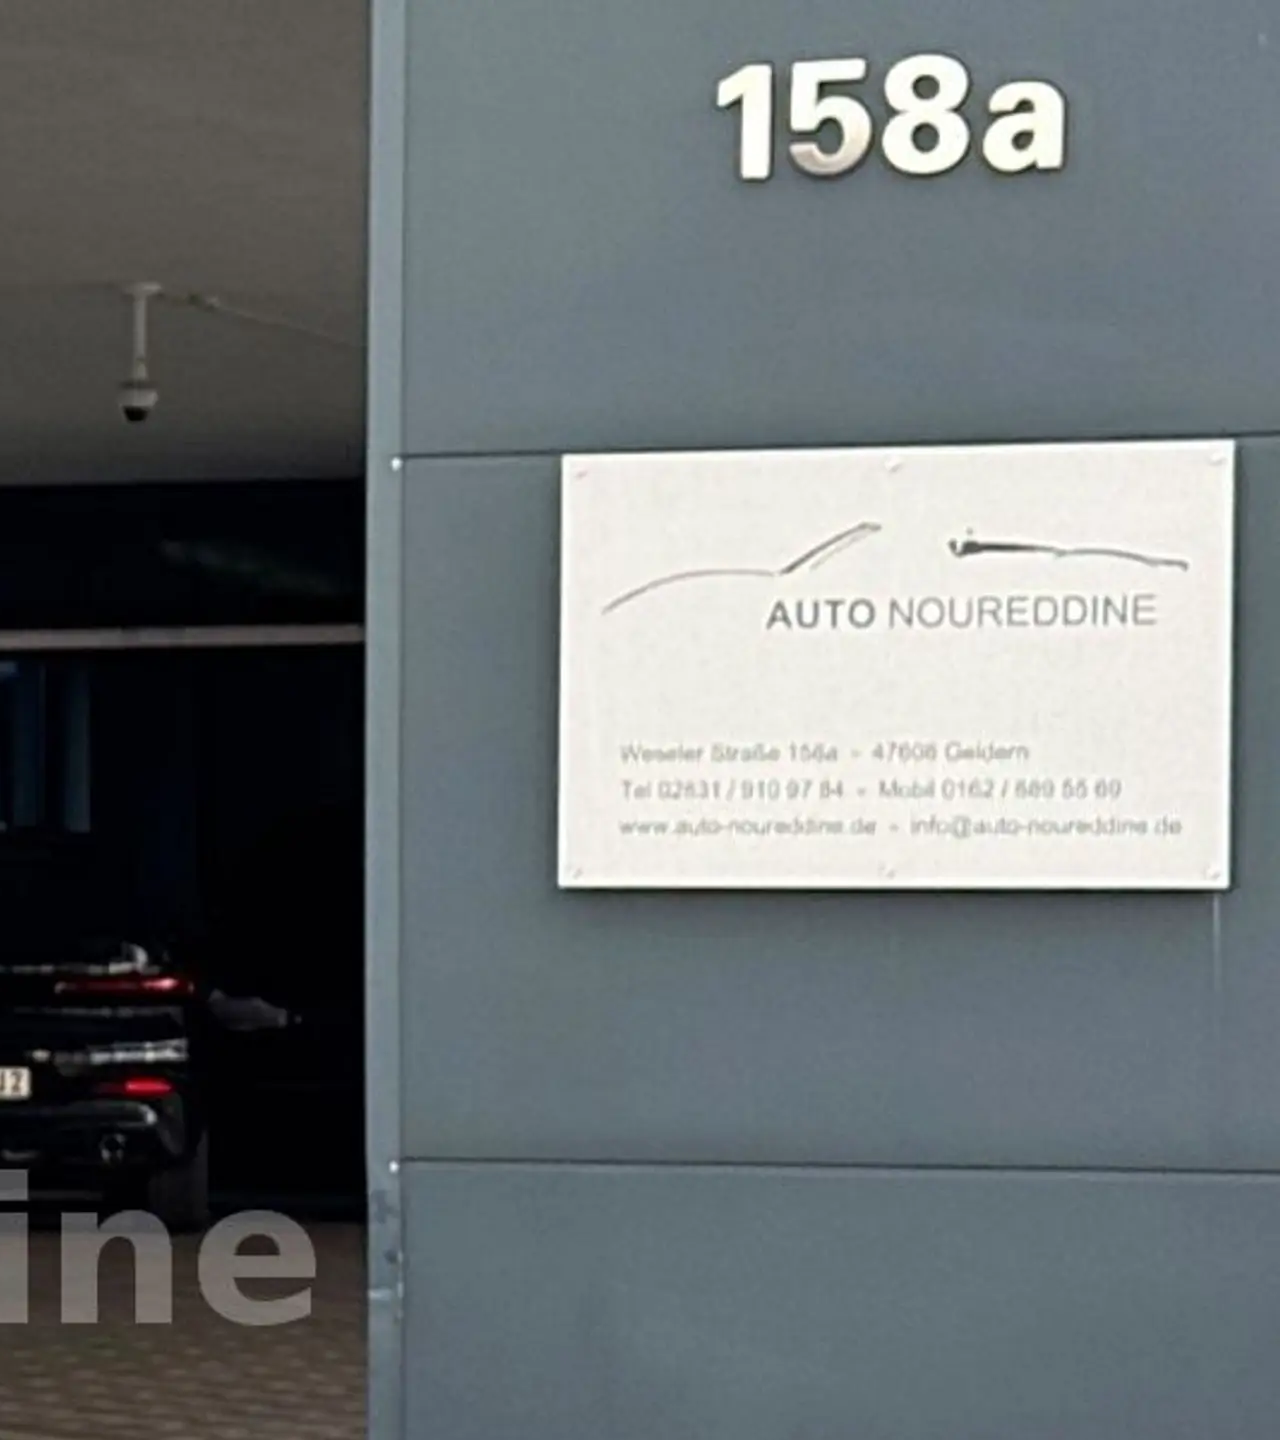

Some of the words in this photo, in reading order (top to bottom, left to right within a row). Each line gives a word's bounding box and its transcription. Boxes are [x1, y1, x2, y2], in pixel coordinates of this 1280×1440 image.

[716, 54, 1066, 179] 158a
[765, 598, 877, 630] AUTO
[888, 593, 1159, 629] NOUREDDINE
[711, 742, 781, 763] Straße
[944, 740, 1031, 764] Geldern
[621, 778, 653, 799] Tel
[878, 778, 936, 799] Mobil
[618, 816, 878, 837] www.auto-noureddine.de
[910, 814, 1184, 841] info@auto-noureddine.de
